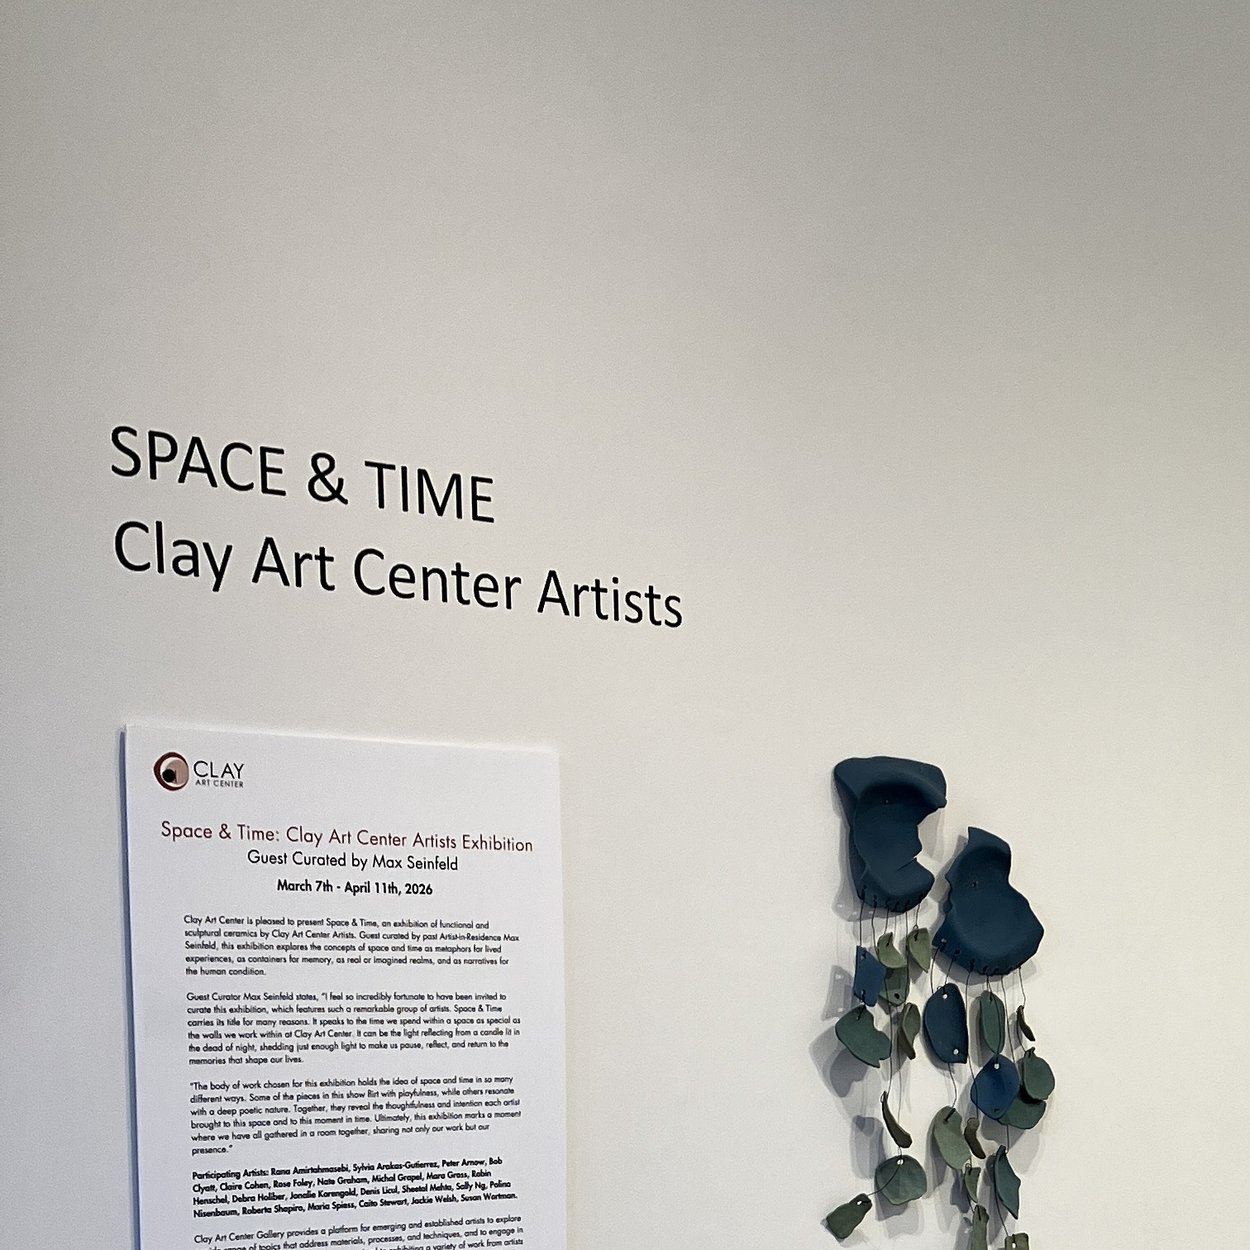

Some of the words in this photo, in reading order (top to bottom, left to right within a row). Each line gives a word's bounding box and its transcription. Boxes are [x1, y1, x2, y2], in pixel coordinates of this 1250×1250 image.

[111, 426, 286, 496] SPACE
[308, 452, 348, 505] &
[364, 460, 494, 523] TIME
[115, 520, 233, 592] Clay
[251, 536, 335, 591] Art
[354, 548, 521, 610] Center
[537, 570, 682, 628] Artists
[193, 760, 245, 779] CLAY
[213, 780, 243, 788] CENTER
[161, 820, 212, 842] Space
[219, 823, 231, 839] &
[237, 824, 279, 842] Time:
[286, 825, 323, 848] Clay
[328, 828, 351, 844] Art
[357, 829, 407, 846] Center
[412, 832, 457, 849] Artists
[462, 834, 533, 852] Exhibition
[247, 849, 287, 865] Guest
[292, 851, 346, 867] Curated
[351, 852, 368, 871] by
[372, 854, 402, 869] Max
[407, 855, 458, 871] Seinfeld
[277, 878, 312, 892] March
[315, 879, 333, 892] 7th
[344, 880, 371, 896] April
[375, 881, 402, 896] 11th,
[405, 883, 433, 895] 2026
[183, 915, 203, 926] Clay
[204, 916, 217, 924] Art
[218, 915, 244, 924] Center
[255, 916, 285, 927] pleased
[296, 919, 324, 928] present
[326, 917, 349, 929] Space
[393, 919, 428, 928] exhibition
[439, 919, 473, 929] functional
[184, 928, 221, 939] sculptural
[223, 930, 257, 938] ceramics
[271, 929, 290, 940] Clay
[291, 930, 303, 938] Art
[305, 929, 330, 938] Center
[359, 930, 380, 939] Guest
[382, 931, 409, 940] curated
[422, 933, 438, 942] past
[503, 934, 519, 942] Max
[221, 941, 234, 950] this
[236, 941, 274, 950] exhibition
[276, 942, 308, 952] explores
[323, 944, 356, 953] concepts
[367, 945, 389, 954] space
[435, 944, 472, 954] metaphors
[485, 944, 502, 953] lived
[301, 957, 334, 966] memory,
[347, 955, 361, 964] real
[373, 955, 408, 966] imagined
[200, 966, 226, 975] human
[213, 1004, 227, 1014] this
[271, 1004, 294, 1013] which
[296, 1004, 325, 1013] features
[353, 1004, 395, 1013] remarkable
[396, 1006, 418, 1015] group
[429, 1005, 451, 1013] artists.
[454, 1004, 476, 1014] Space
[485, 1004, 502, 1012] Time
[188, 1057, 226, 1065] memories
[228, 1055, 243, 1064] that
[245, 1055, 268, 1065] shape
[285, 1054, 304, 1063] lives.
[190, 1094, 222, 1103] different
[223, 1096, 246, 1104] ways.
[249, 1093, 271, 1102] Some
[331, 1090, 344, 1099] this
[346, 1090, 366, 1099] show
[380, 1089, 396, 1097] with
[441, 1087, 460, 1096] while
[462, 1087, 483, 1095] others
[190, 1107, 207, 1116] with
[216, 1107, 237, 1117] deep
[239, 1107, 262, 1117] poetic
[264, 1106, 291, 1114] nature.
[293, 1104, 328, 1115] Together,
[348, 1102, 370, 1111] reveal
[385, 1100, 435, 1112] thoughtfulness
[453, 1100, 483, 1108] intention
[484, 1098, 502, 1107] each
[503, 1098, 520, 1106] artist
[192, 1169, 241, 1181] Participating
[242, 1168, 269, 1177] Artists:
[271, 1167, 291, 1176] Rana
[353, 1162, 375, 1174] Sylvia
[442, 1159, 460, 1167] Peter
[489, 1156, 503, 1165] Bob
[219, 1182, 242, 1191] Claire
[244, 1180, 271, 1190] Cohen,
[273, 1180, 291, 1188] Rose
[317, 1177, 335, 1186] Nate
[337, 1175, 370, 1185] Graham,
[471, 1169, 492, 1178] Robin
[242, 1205, 272, 1215] Roberta
[274, 1204, 305, 1215] Shapiro,
[307, 1202, 330, 1211] Maria
[410, 1195, 433, 1205] Jackie
[434, 1194, 459, 1203] Welsh,
[460, 1193, 482, 1202] Susan
[194, 1234, 213, 1245] Clay
[214, 1234, 227, 1242] Art
[228, 1232, 254, 1241] Center
[256, 1229, 285, 1239] Gallery
[286, 1227, 319, 1239] provides
[328, 1224, 358, 1236] platform
[372, 1223, 406, 1233] emerging
[424, 1217, 463, 1228] established
[465, 1217, 485, 1225] artists
[495, 1214, 521, 1224] explore
